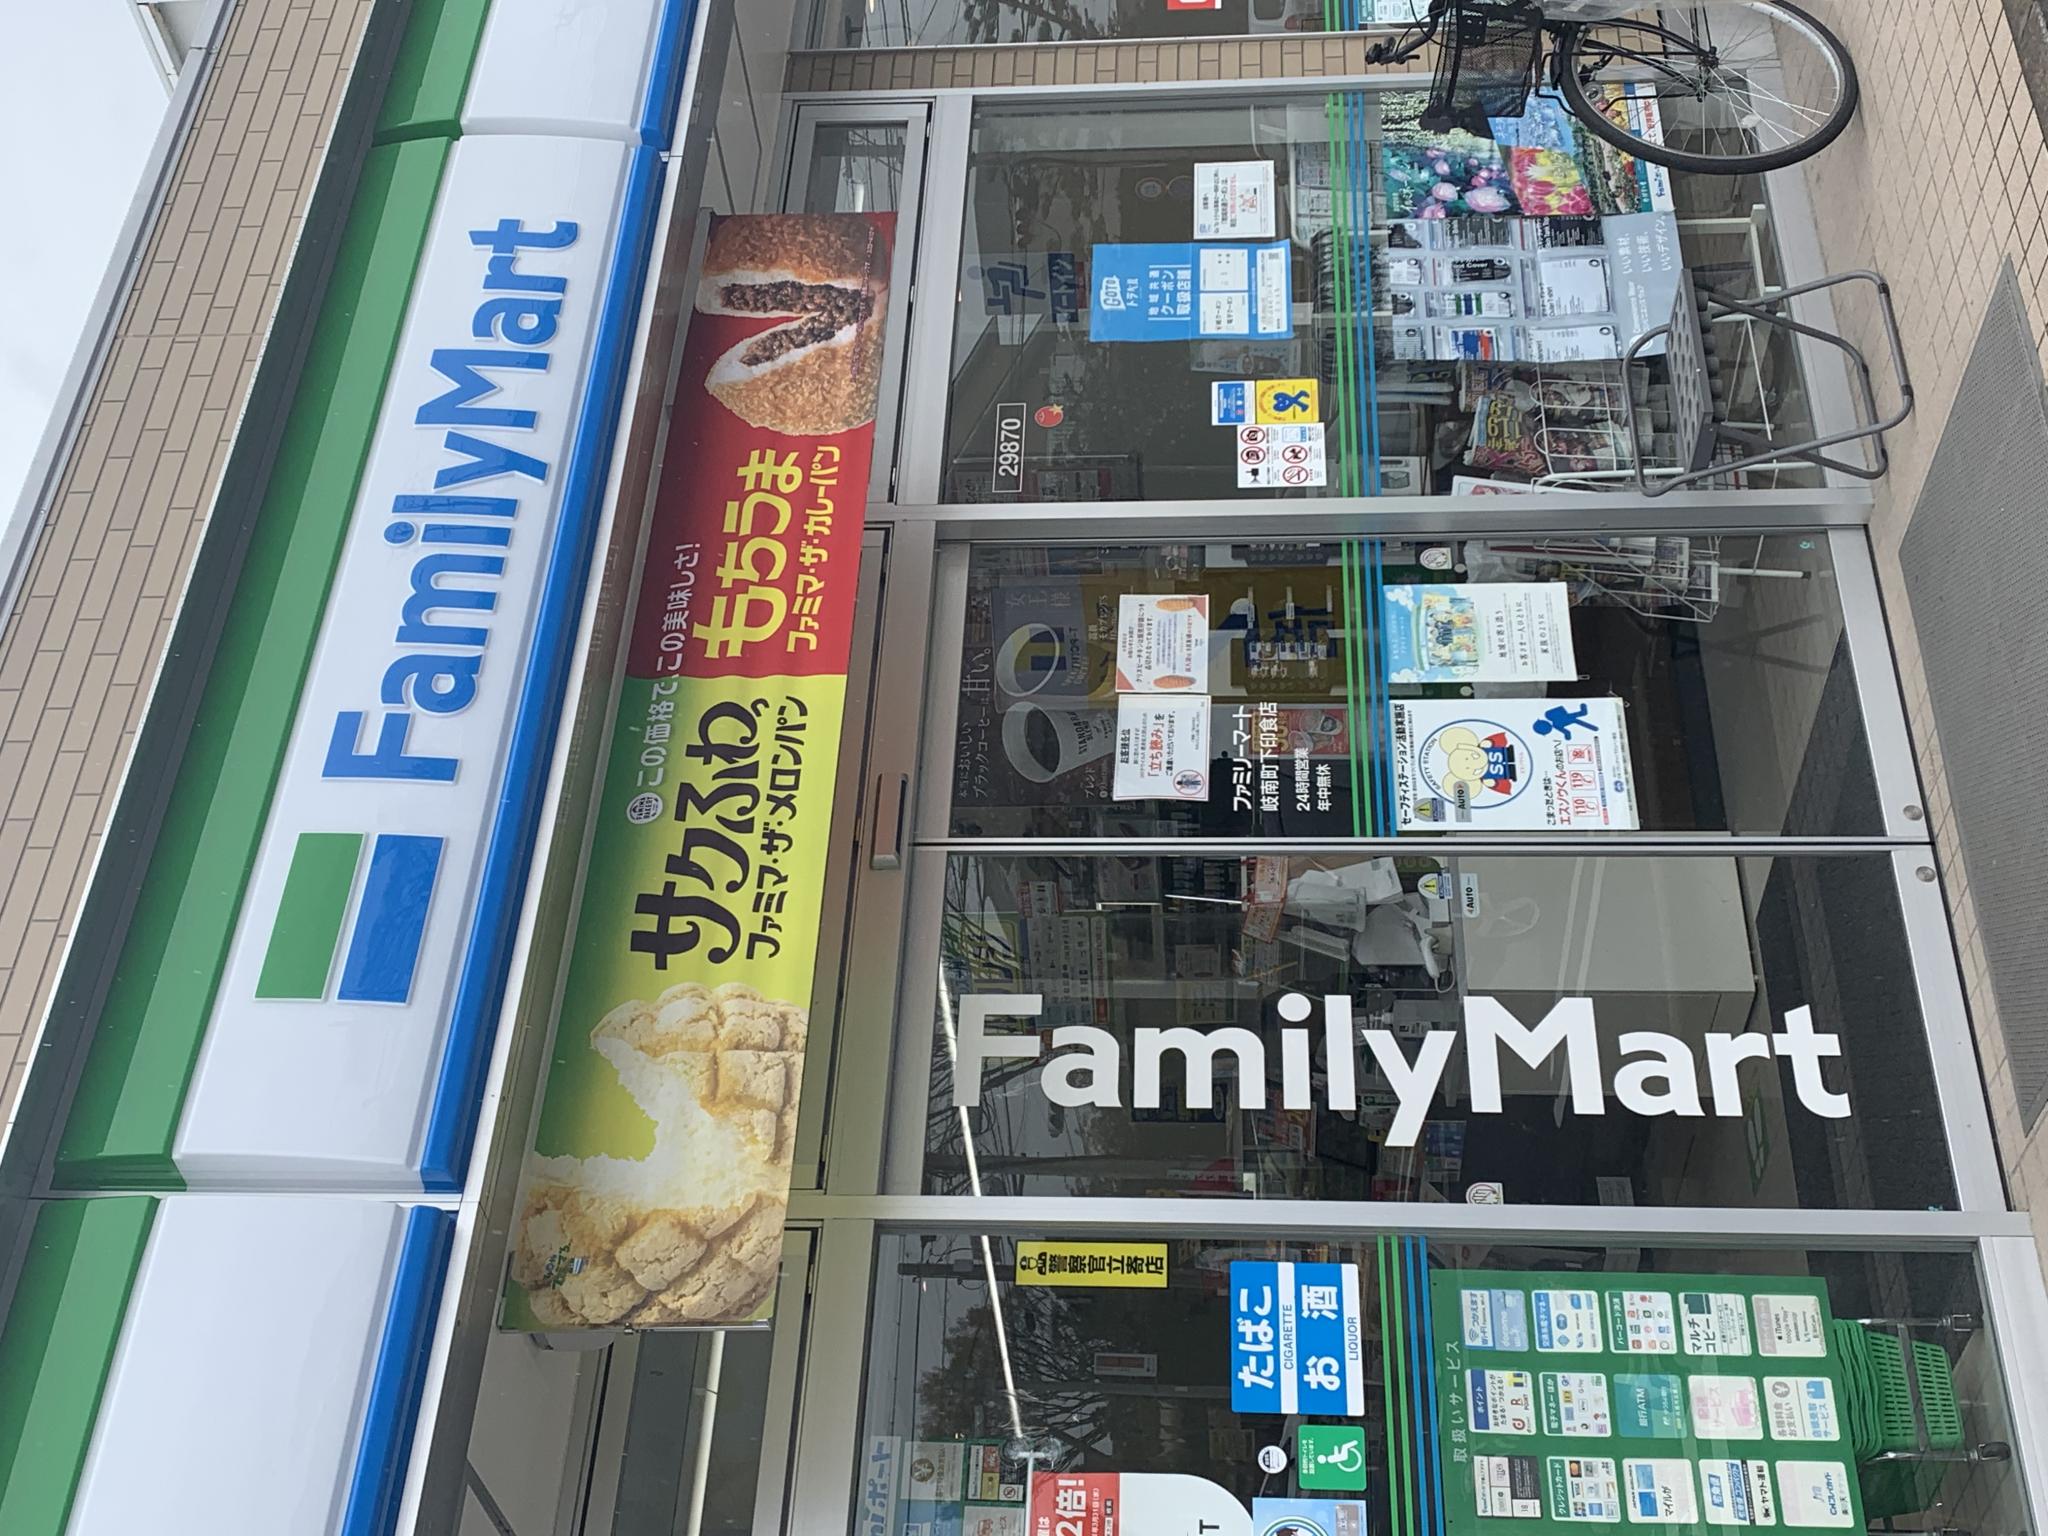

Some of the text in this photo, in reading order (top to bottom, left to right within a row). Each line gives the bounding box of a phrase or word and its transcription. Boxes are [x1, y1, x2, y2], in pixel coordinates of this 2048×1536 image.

[1617, 233, 1634, 274] いい素材、
[1636, 231, 1653, 272] いい技術、
[1656, 215, 1673, 271] いいデザイン。
[1126, 278, 1138, 307] トラベル
[1161, 270, 1175, 315] クーポン
[1176, 269, 1192, 315] 取扱店舗
[999, 416, 1022, 477] 29870
[321, 218, 579, 782] FamilyMart
[692, 448, 803, 658] もちうま
[786, 445, 840, 652] ファミマ・ザ・カレーパン
[1494, 610, 1507, 658] 地域に寄り添う
[957, 721, 974, 798] 本当においしい
[1120, 728, 1130, 764] お客様各位
[1148, 713, 1165, 777] 「立ち読み」を
[1165, 710, 1176, 776] ご遠慮いただいております。
[1232, 704, 1252, 811] ファミリーマート
[1259, 702, 1280, 811] 岐南町下印食店
[1394, 704, 1412, 825] セーフティステーション活動実施店
[1423, 737, 1441, 790] SAFETY STATION
[1295, 747, 1310, 811] 24時間営業
[1315, 764, 1332, 811] 年中無休
[1457, 789, 1467, 809] Auto
[1571, 772, 1583, 788] 119
[746, 696, 808, 960] ファミマ・ザ・メロンパン
[1574, 798, 1586, 815] 110
[1466, 887, 1474, 909] Auto
[952, 992, 1852, 1147] FamilyMart
[1048, 1255, 1165, 1275] 警察官立寄店
[1469, 1292, 1479, 1327] つかえます
[1612, 1297, 1625, 1345] バーコード決済
[1774, 1313, 1783, 1334] iTunes
[1237, 1286, 1275, 1389] たばこ
[1282, 1304, 1294, 1370] CIGARETTE
[1347, 1316, 1359, 1361] LIQUOR
[1687, 1318, 1702, 1353] マルチ
[1702, 1318, 1716, 1353] コピー
[1446, 1340, 1468, 1463] 取扱いサービス
[1475, 1386, 1485, 1413] ポイント
[1549, 1394, 1559, 1428] 電子マネー
[1636, 1388, 1648, 1426] 銀行ATM
[1774, 1402, 1787, 1437] 各種料金
[1784, 1402, 1797, 1437] お支払い
[1819, 1403, 1832, 1438] サービス
[1554, 1462, 1567, 1515] クレジットカード
[1661, 1485, 1674, 1517] マイルが
